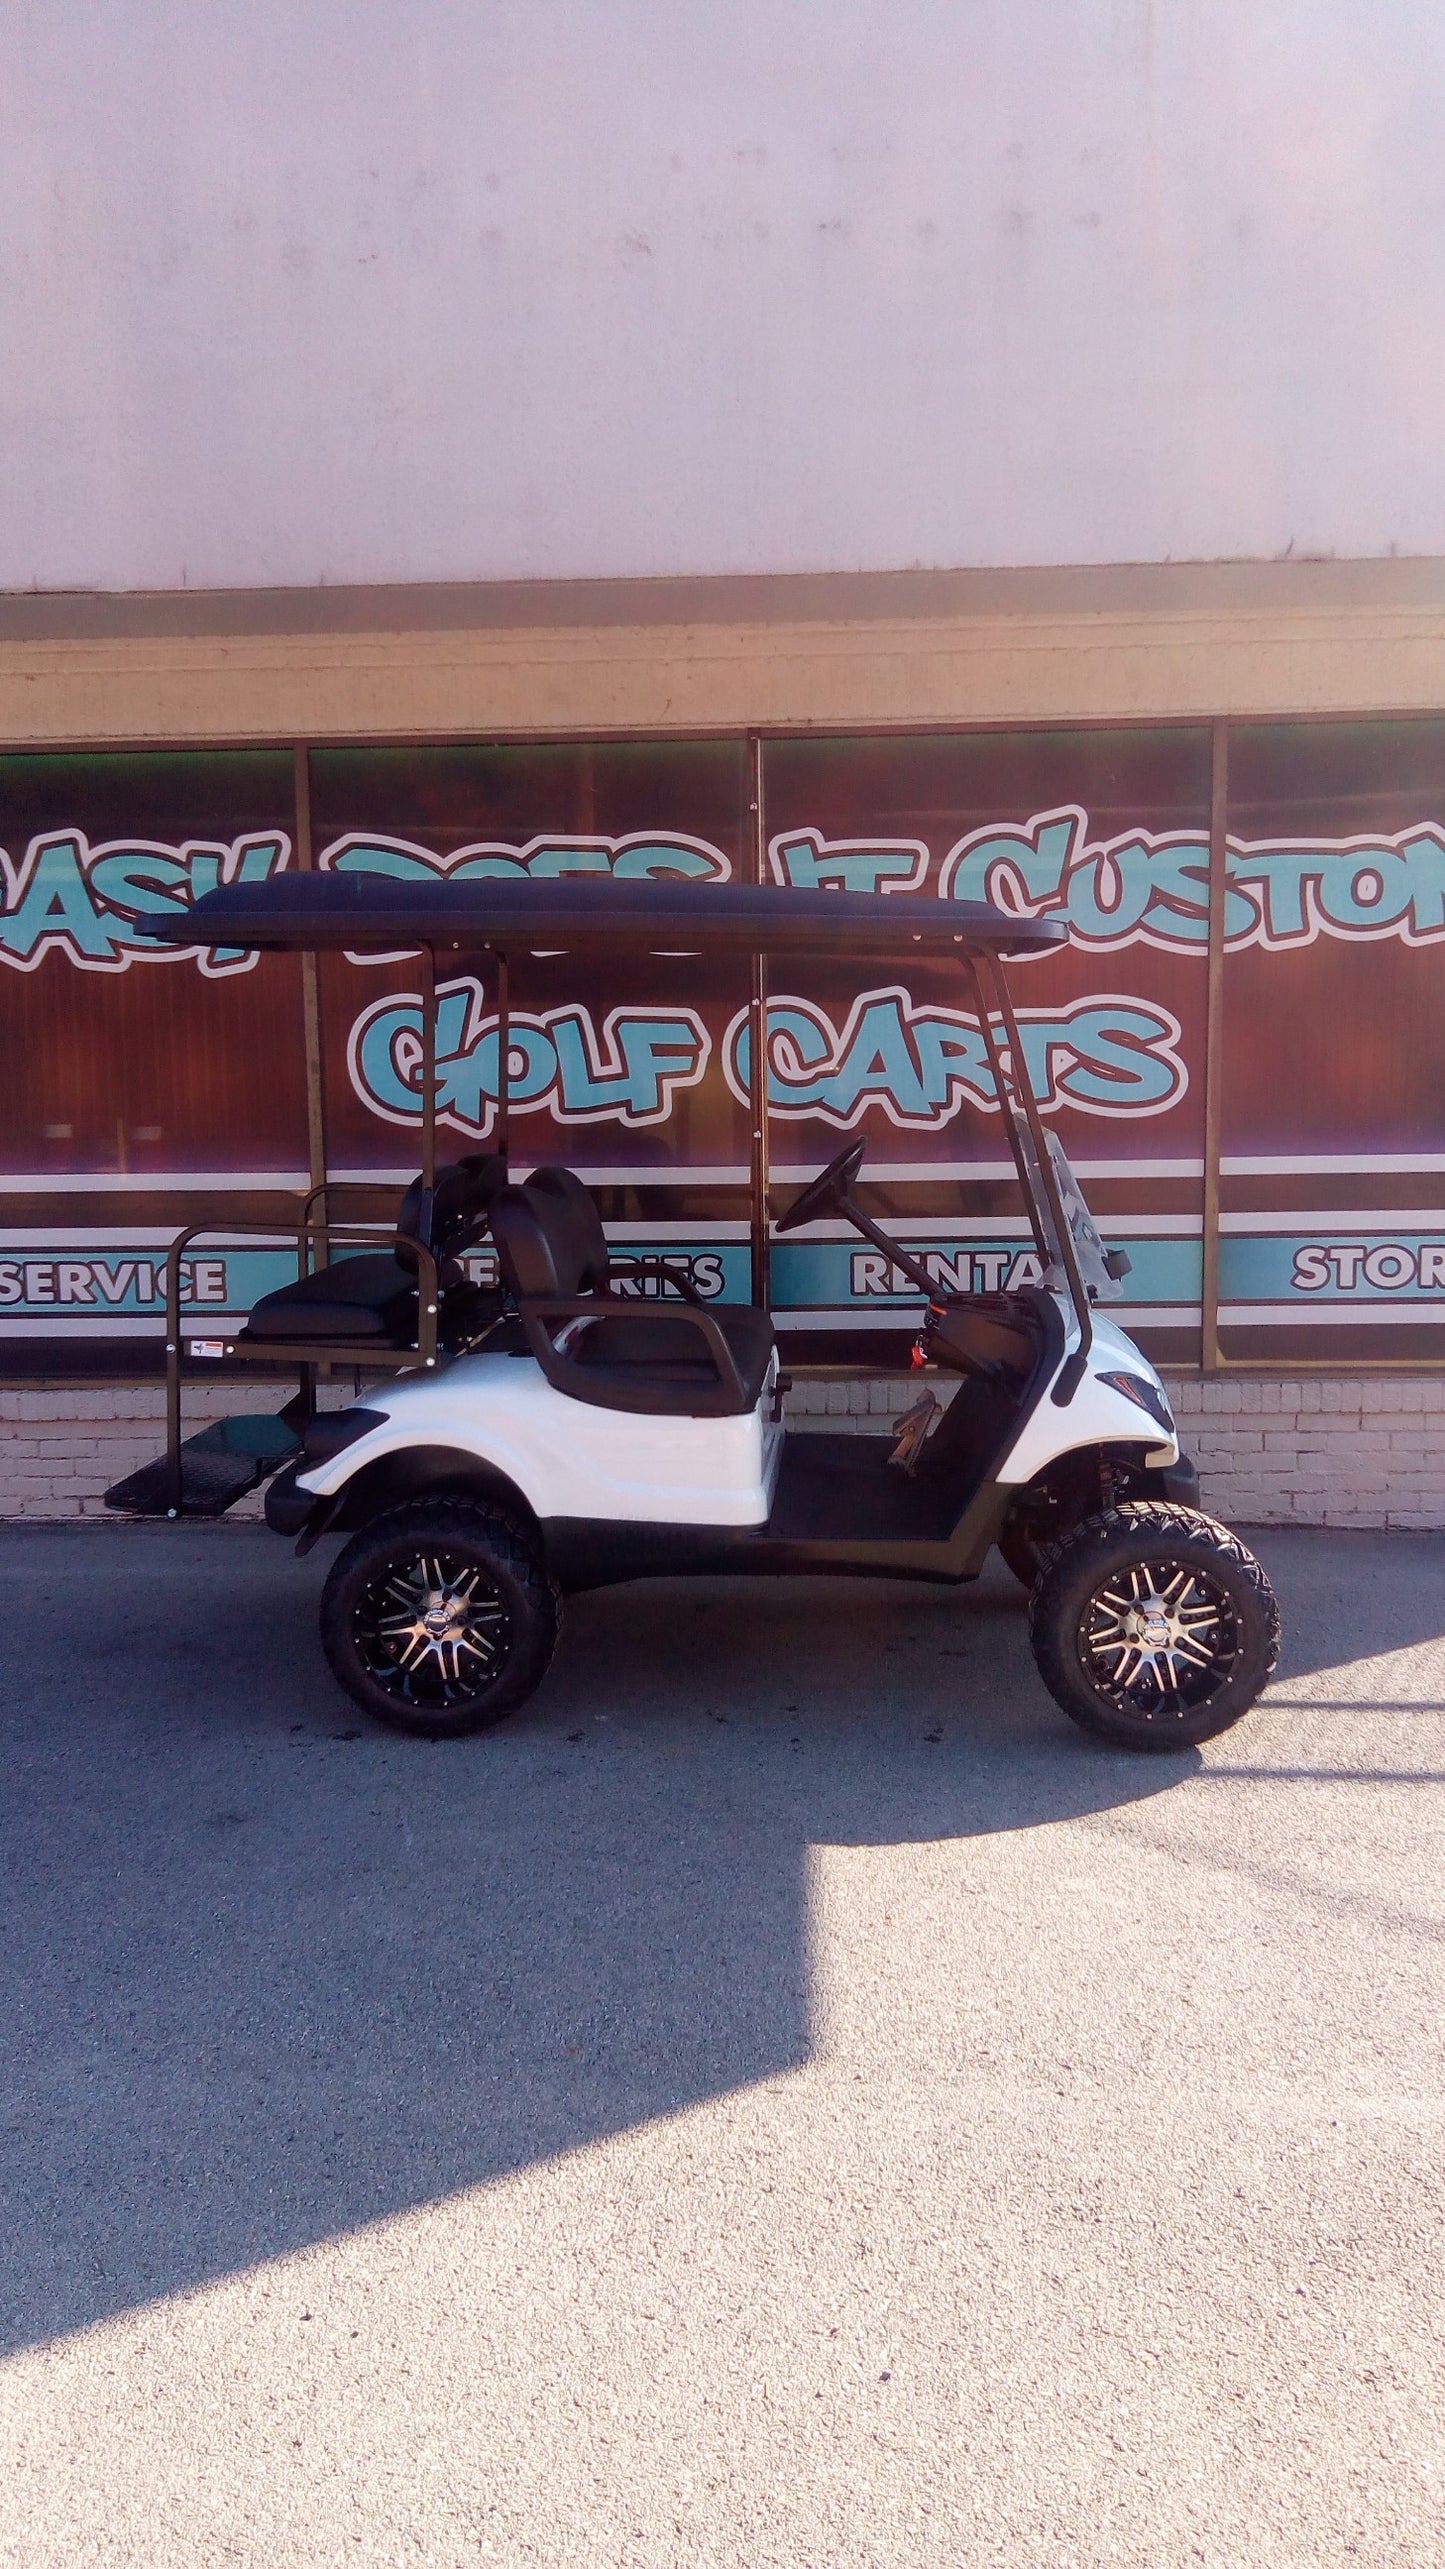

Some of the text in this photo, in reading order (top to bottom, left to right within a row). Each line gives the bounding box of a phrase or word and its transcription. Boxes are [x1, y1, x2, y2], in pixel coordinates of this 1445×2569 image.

[0, 834, 284, 972] ASY
[352, 982, 1182, 1134] GOLF CARTS
[0, 1260, 226, 1304] SERVICE
[850, 1251, 1050, 1295] RENTA
